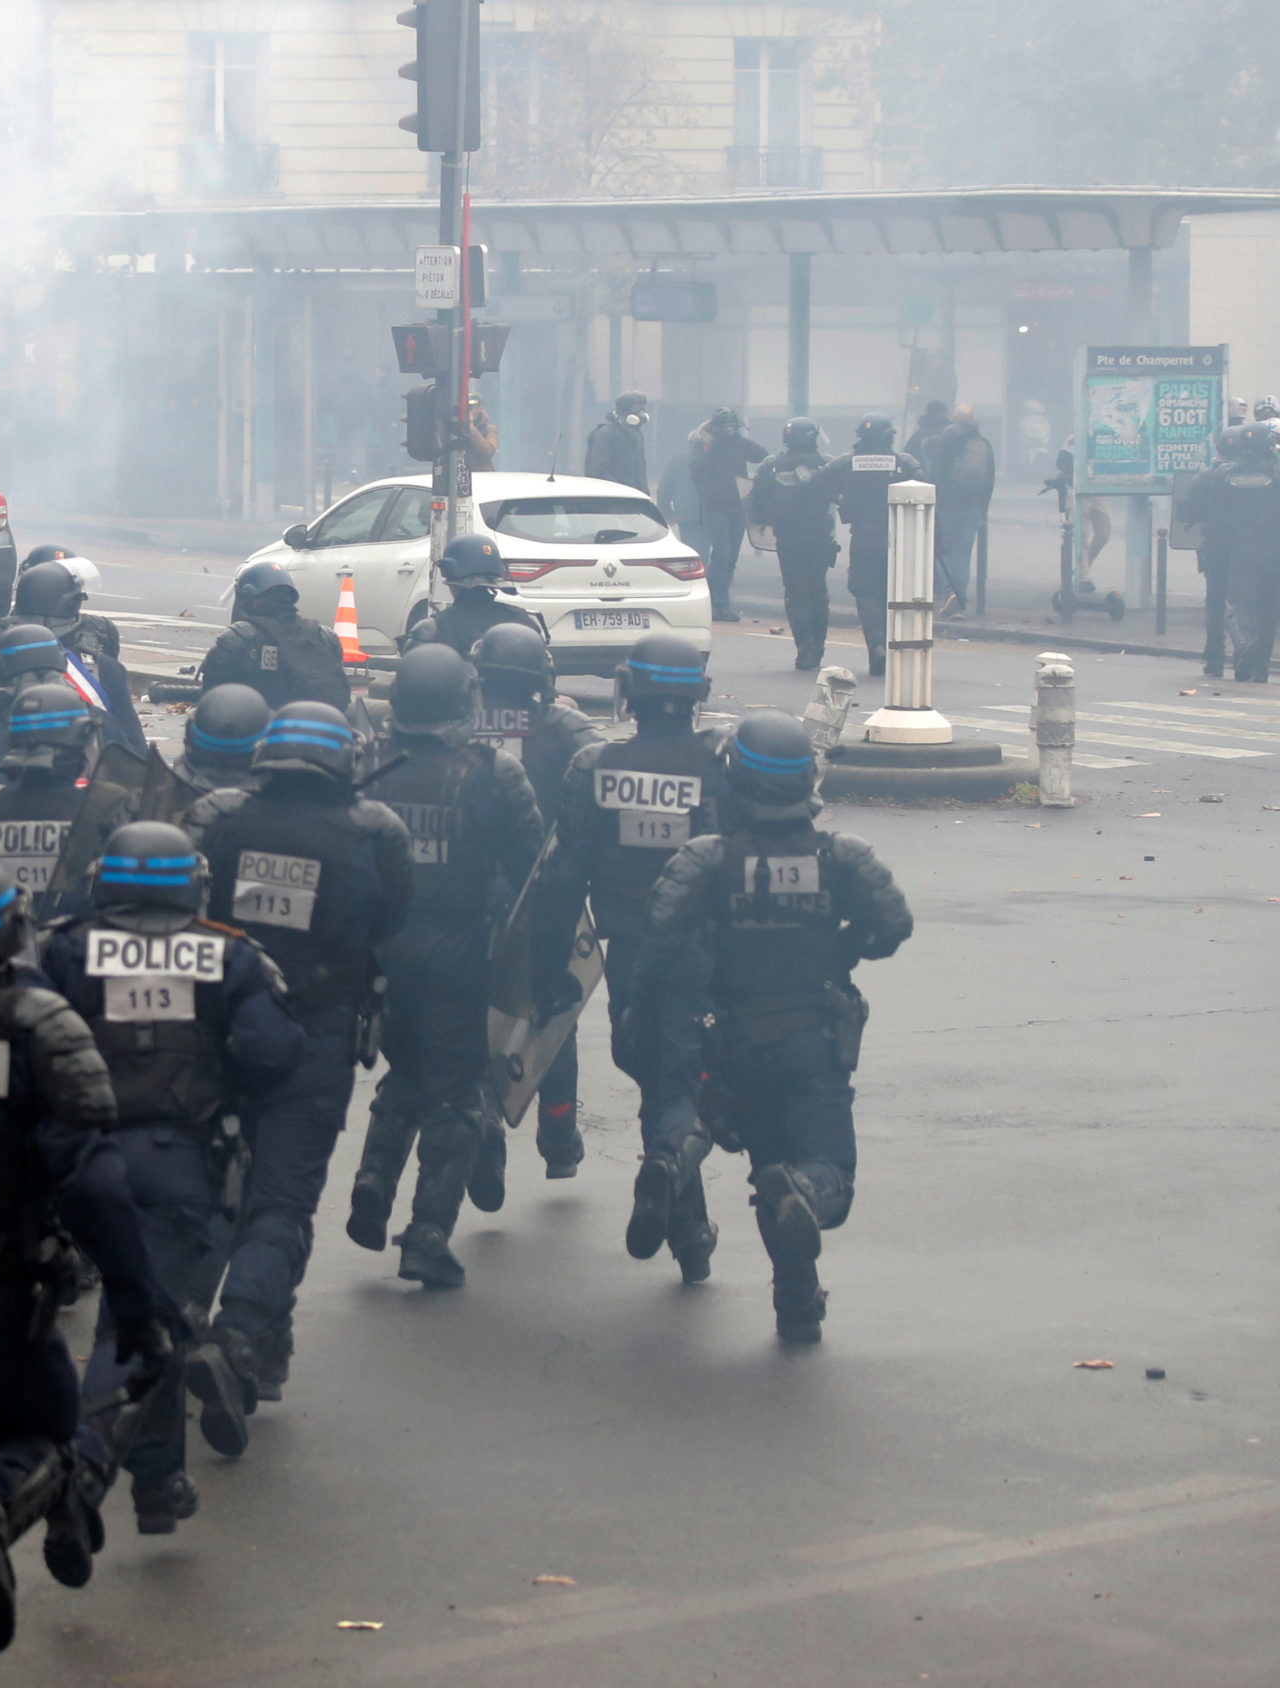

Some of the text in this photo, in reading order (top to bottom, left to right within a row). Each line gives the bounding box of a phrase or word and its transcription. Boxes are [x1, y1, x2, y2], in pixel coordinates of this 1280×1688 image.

[1097, 355, 1194, 367] Pte de Champerret
[1159, 383, 1209, 398] PARIS
[1159, 409, 1207, 426] 6 OCT
[582, 612, 642, 627] EH-759-AD
[600, 774, 694, 810] POLICE
[638, 821, 672, 839] 113
[17, 866, 48, 882] C11
[241, 855, 317, 885] POLICE
[254, 894, 292, 916] 113
[97, 938, 215, 974] POLICE
[129, 988, 171, 1009] 113
